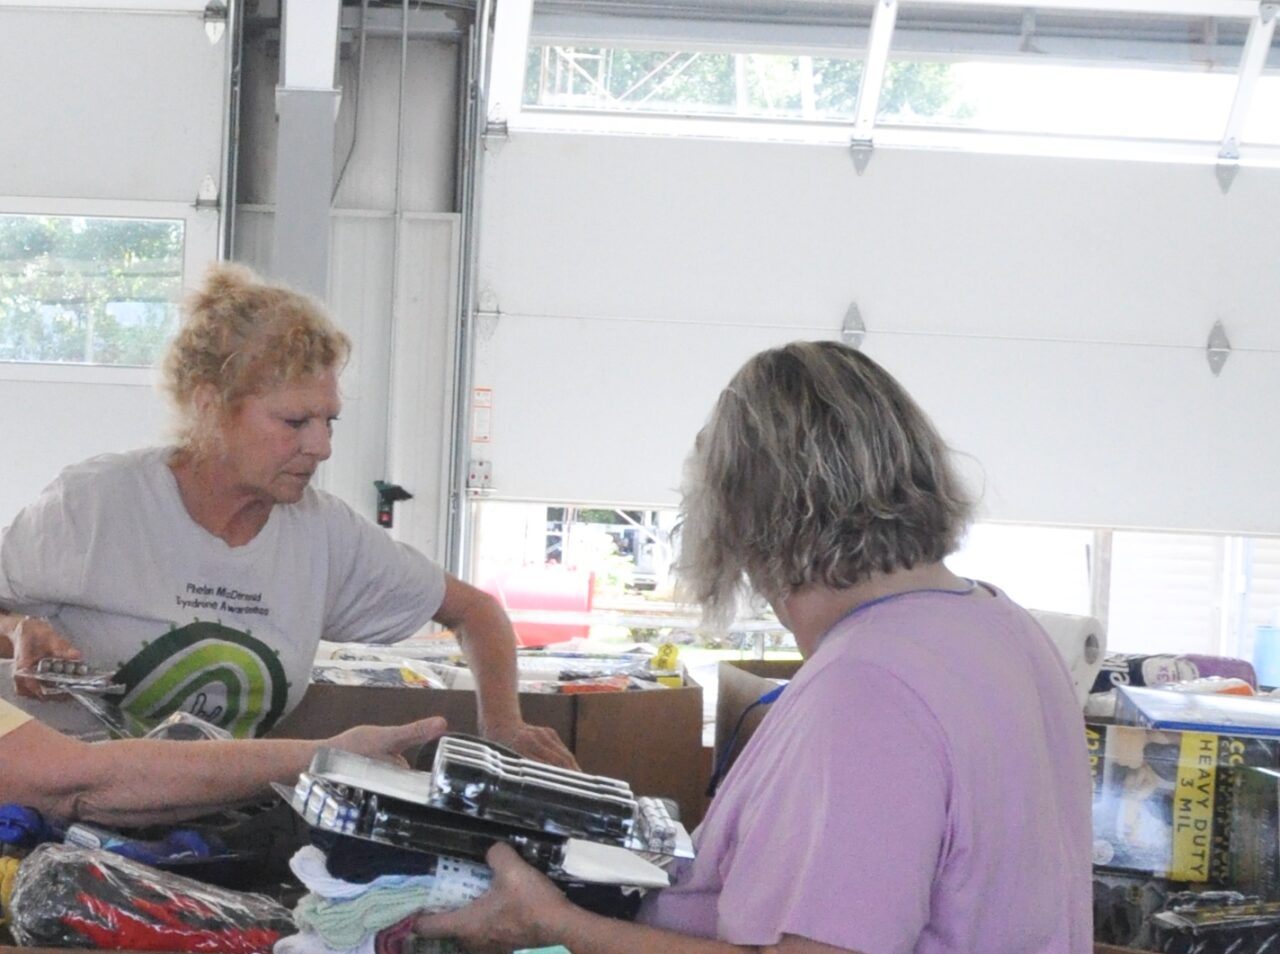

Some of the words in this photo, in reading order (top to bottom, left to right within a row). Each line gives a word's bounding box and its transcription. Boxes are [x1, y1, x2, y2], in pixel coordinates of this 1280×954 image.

[1180, 777, 1195, 788] 3
[1195, 739, 1214, 809] HEAVY
[1177, 797, 1193, 833] MIL
[1190, 818, 1208, 876] DUTY
